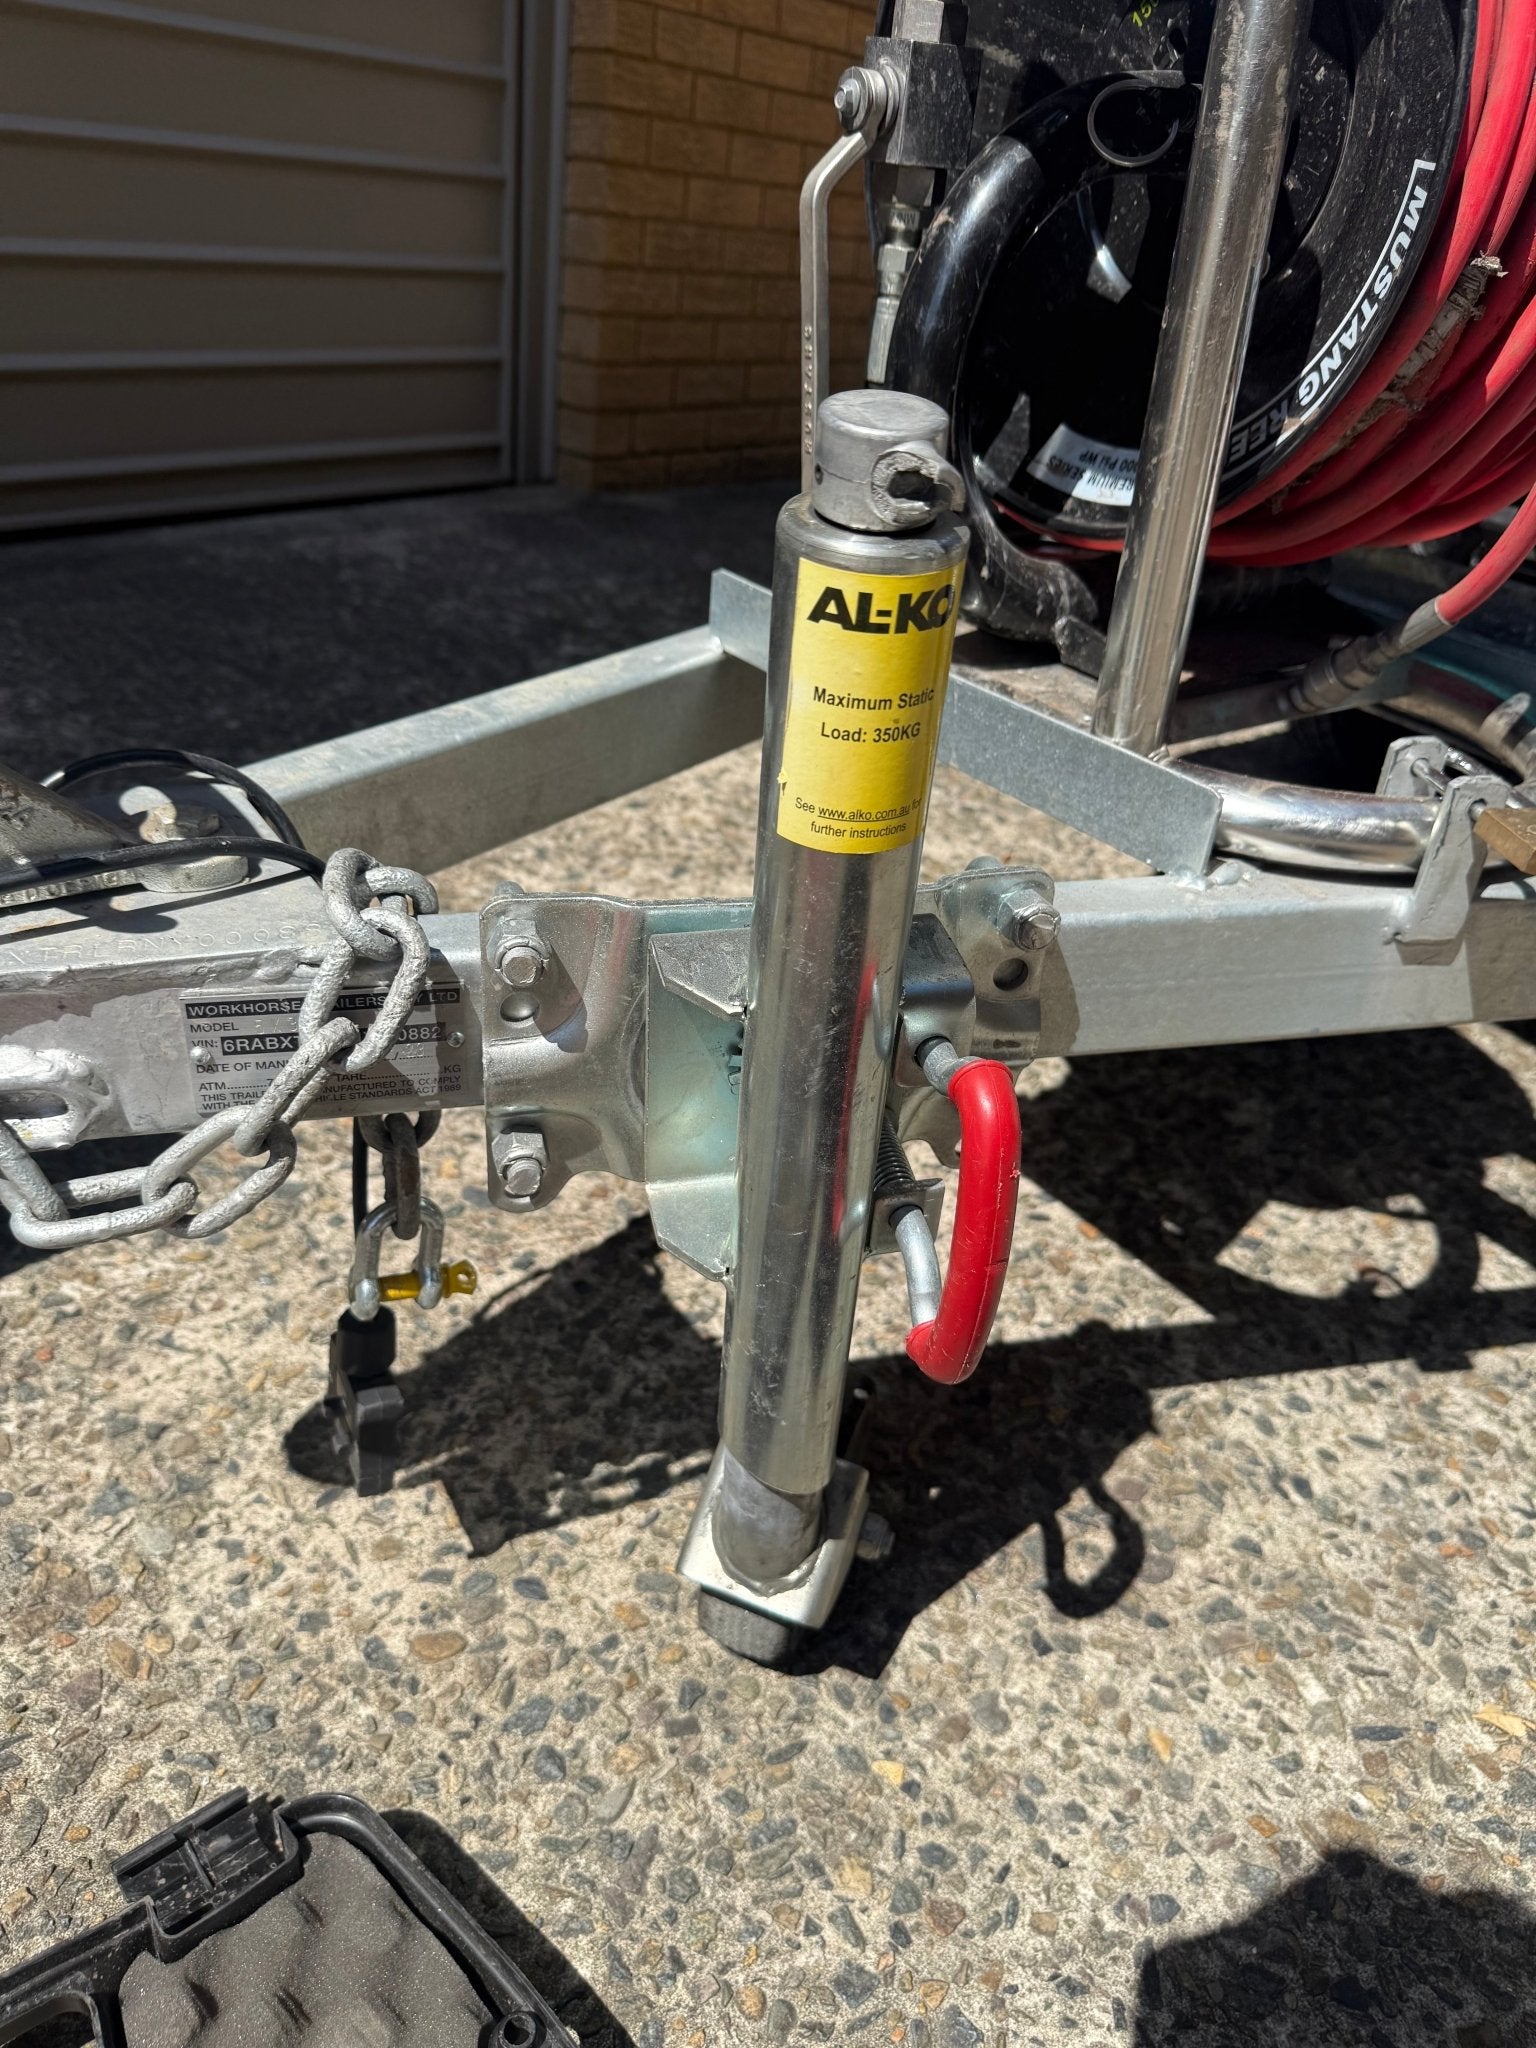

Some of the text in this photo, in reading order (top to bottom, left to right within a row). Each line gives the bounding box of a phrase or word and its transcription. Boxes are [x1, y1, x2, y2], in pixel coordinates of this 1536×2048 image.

[1298, 186, 1428, 406] MUSTANG
[1230, 400, 1289, 460] REE
[1087, 470, 1134, 491] REMIUM
[807, 584, 954, 635] AL-KO
[813, 686, 935, 711] Maximum Static
[821, 722, 921, 744] Load: 350KG
[795, 797, 815, 814] See
[818, 803, 911, 822] www.alko.com.au
[811, 821, 906, 839] further instructions
[188, 1001, 301, 1017] WORKHORSE
[429, 991, 458, 1003] LTD
[190, 1022, 239, 1033] MODEL
[192, 1039, 218, 1048] VIN:
[196, 1062, 230, 1074] DATE
[234, 1061, 251, 1071] OF
[201, 1093, 227, 1103] THIS
[401, 1080, 415, 1088] TO
[202, 1101, 230, 1111] WITH
[349, 1090, 413, 1100] STANDARDS
[414, 1086, 436, 1094] ACT
